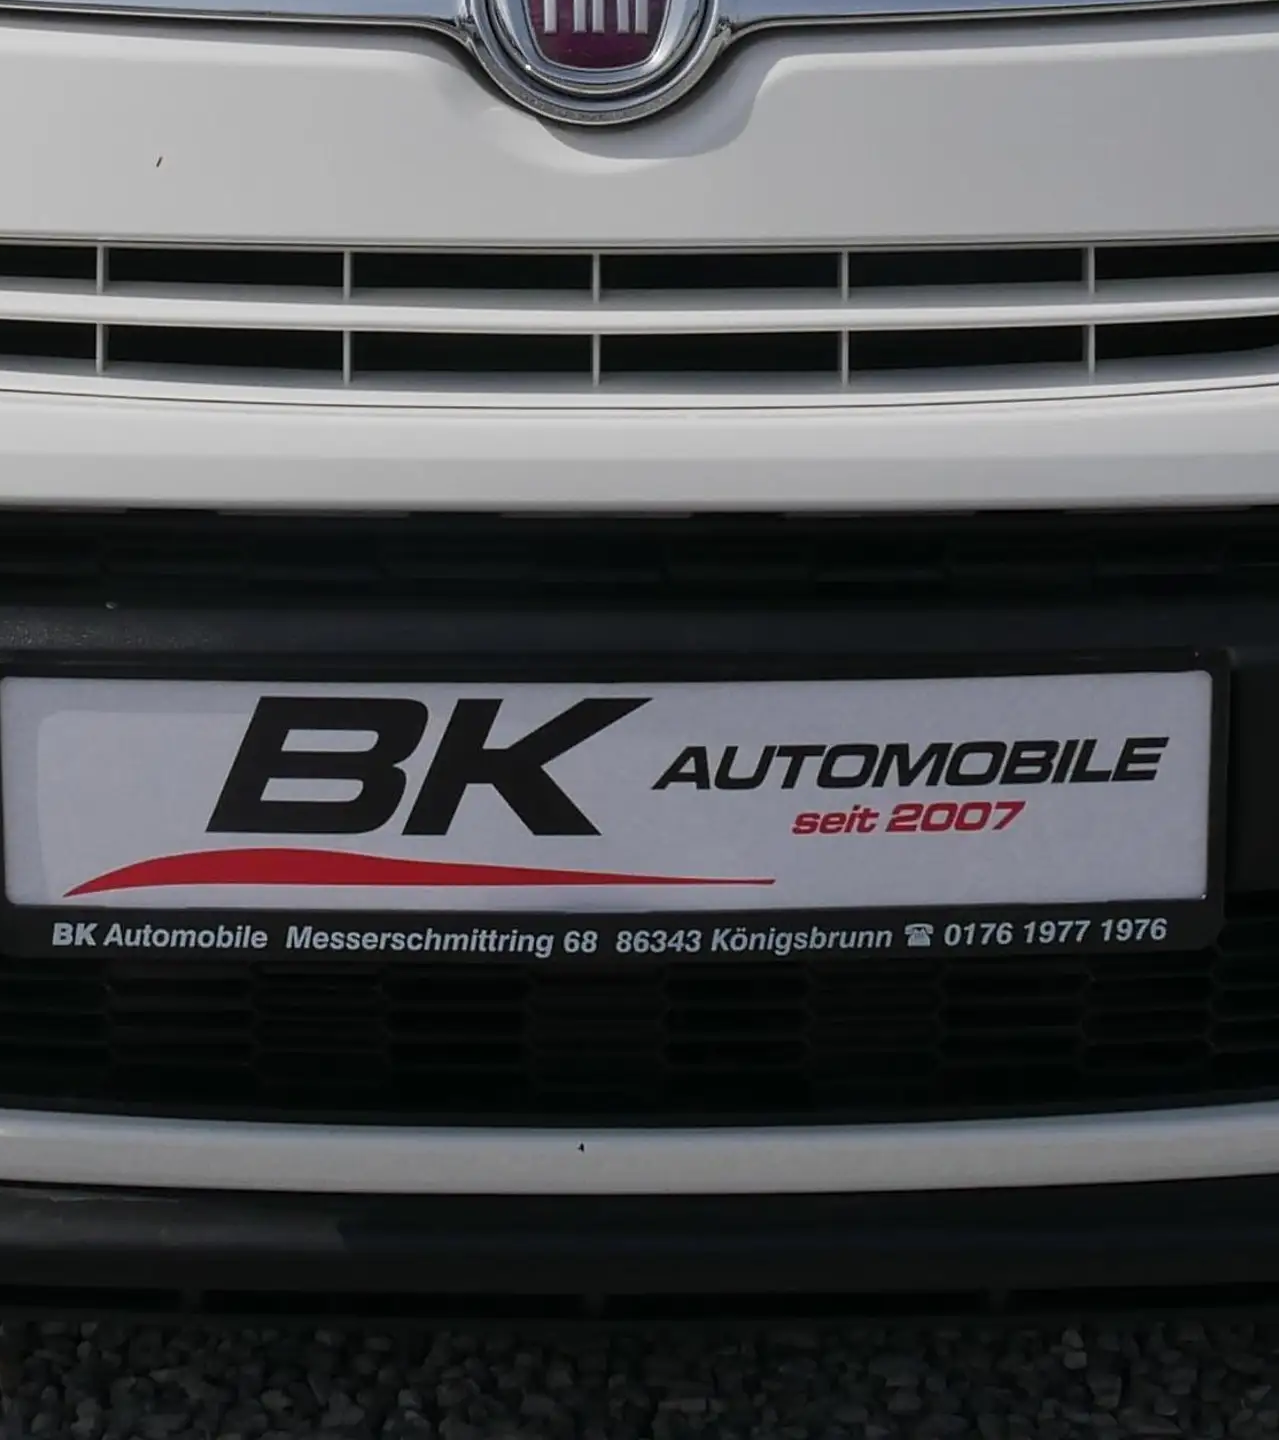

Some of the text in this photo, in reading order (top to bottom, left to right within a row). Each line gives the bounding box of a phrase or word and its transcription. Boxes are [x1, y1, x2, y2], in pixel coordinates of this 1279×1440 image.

[206, 696, 652, 837] BK
[652, 737, 1170, 791] AUTOMOBILE
[792, 800, 1025, 835] seit 2007
[52, 918, 1168, 958] BK Automobile Messerschmittring 68 86343 Königsbrunn 0176 1977 1976
